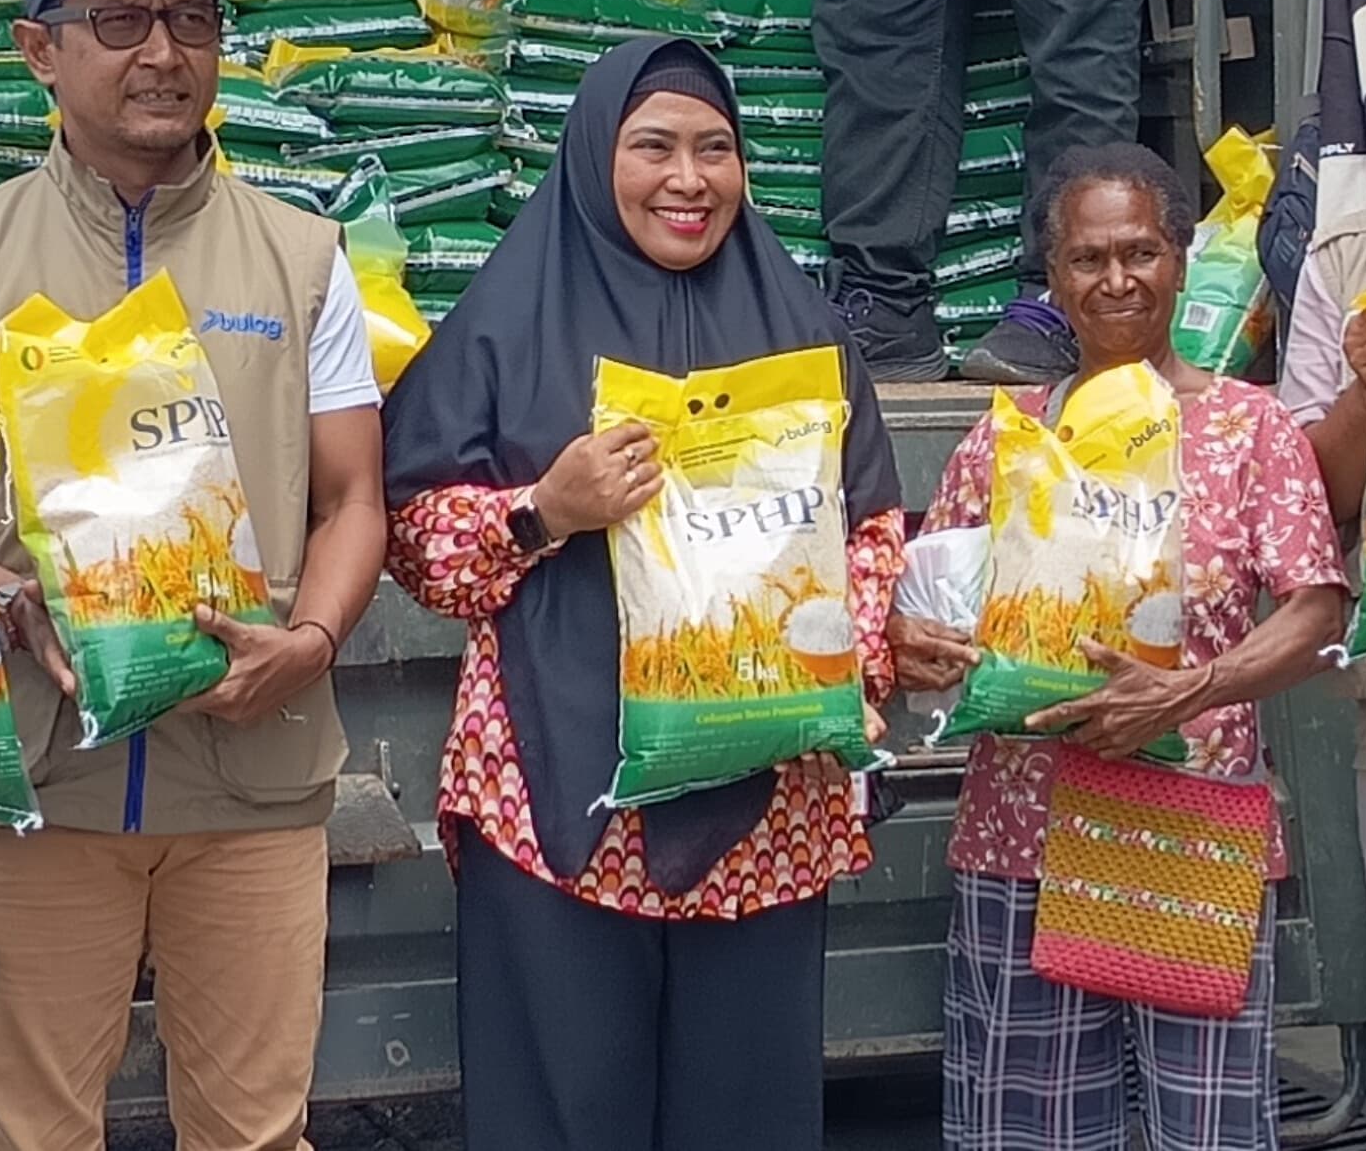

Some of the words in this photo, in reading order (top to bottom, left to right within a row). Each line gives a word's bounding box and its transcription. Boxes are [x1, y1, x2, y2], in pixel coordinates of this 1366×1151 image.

[218, 311, 283, 340] bulog
[786, 420, 833, 442] bulog
[1130, 416, 1173, 447] bulog
[686, 486, 824, 543] SPHP
[196, 572, 211, 598] 5
[737, 657, 753, 682] 5
